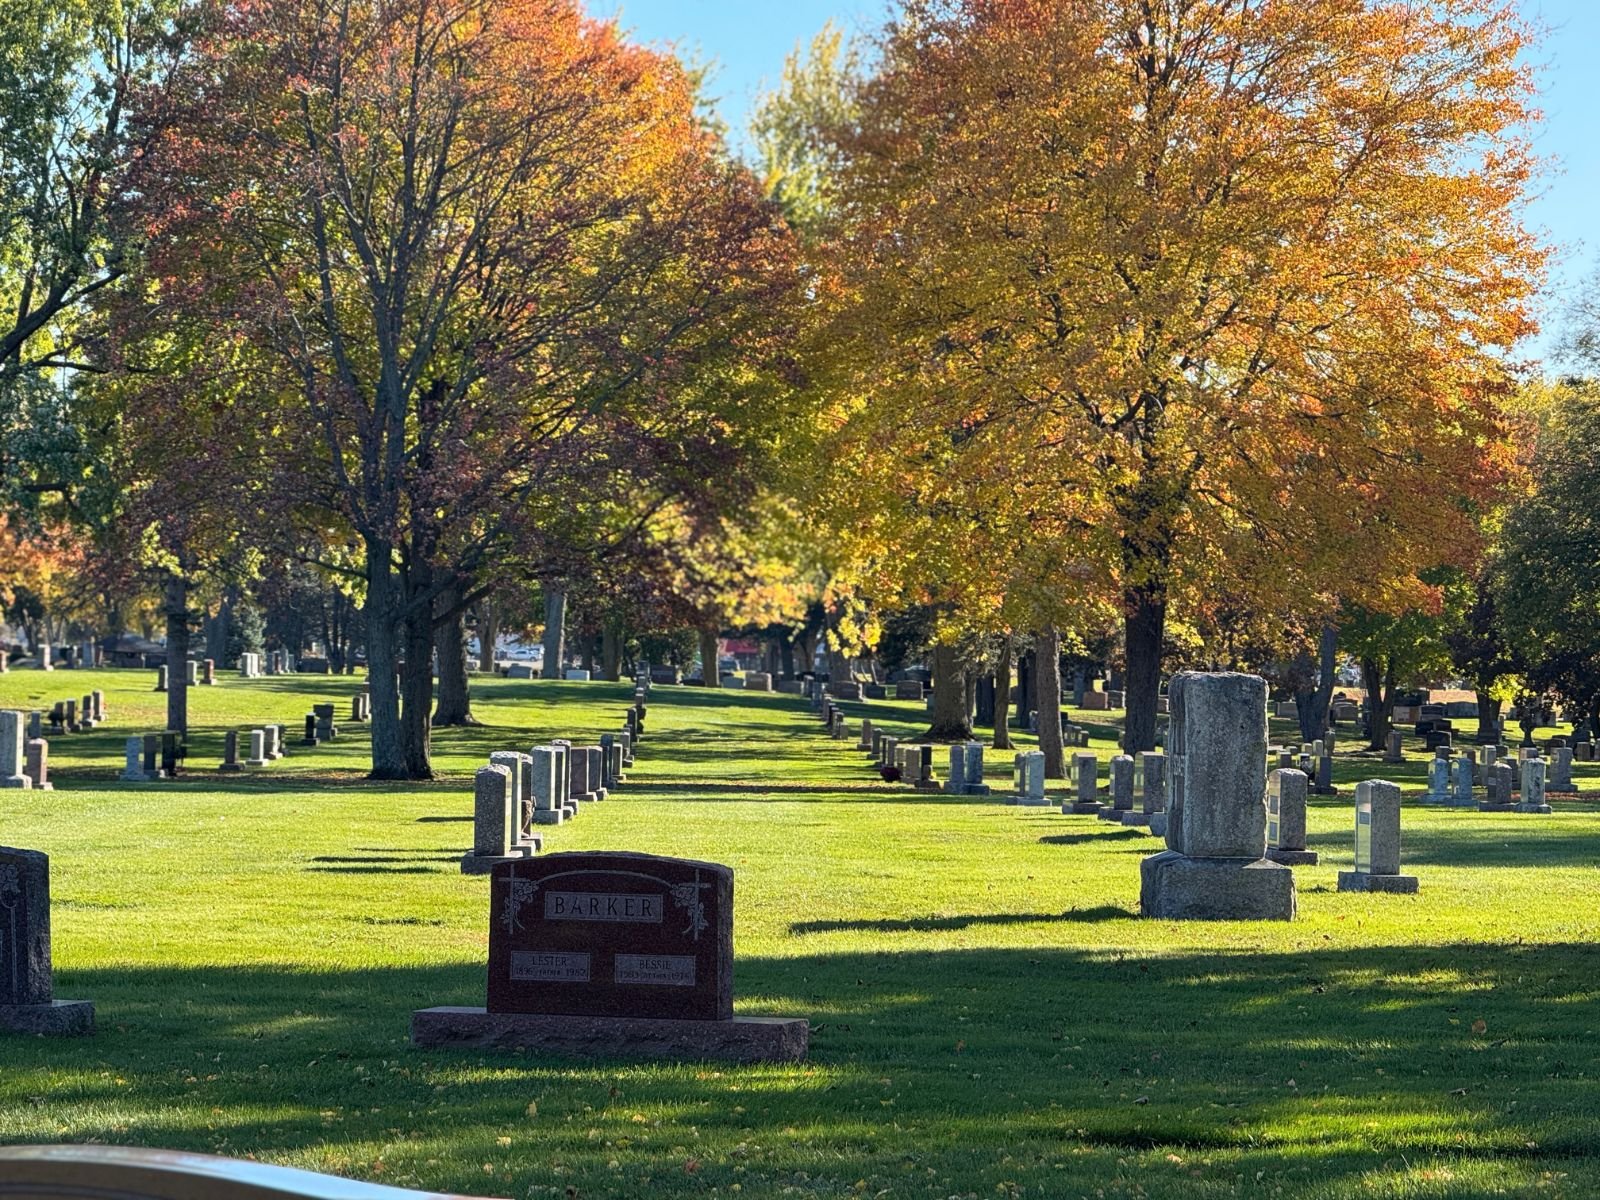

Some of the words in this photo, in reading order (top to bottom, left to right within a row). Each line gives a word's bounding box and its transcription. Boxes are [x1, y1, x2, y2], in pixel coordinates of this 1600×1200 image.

[554, 896, 653, 917] BARKER
[532, 955, 567, 966] LESTER
[639, 959, 671, 970] BESSIE
